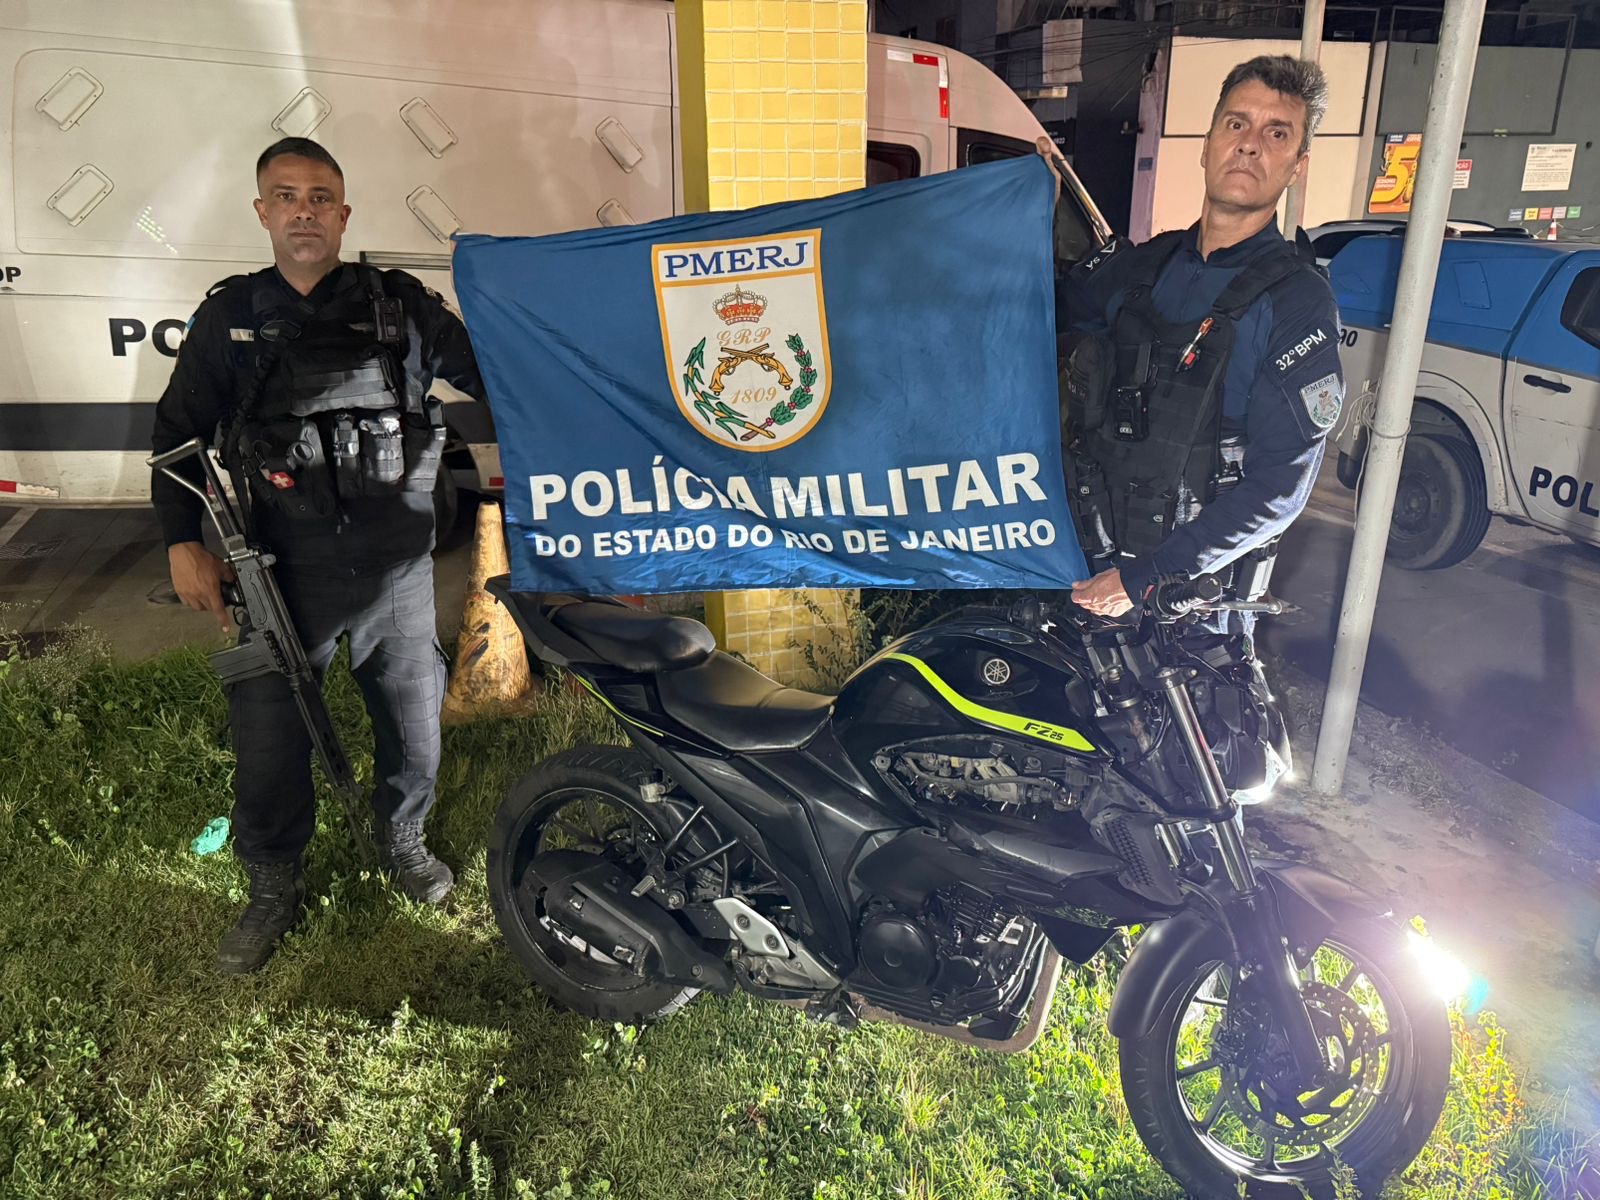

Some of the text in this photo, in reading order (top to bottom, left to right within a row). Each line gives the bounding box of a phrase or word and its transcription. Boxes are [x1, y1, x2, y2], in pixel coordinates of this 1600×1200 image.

[664, 242, 808, 278] PMERJ
[0, 266, 21, 282] P
[717, 327, 771, 346] GRP
[1304, 375, 1335, 393] PMERJ
[730, 387, 777, 404] 1809
[529, 452, 1048, 520] POLÍCIA MILITAR
[1529, 466, 1599, 517] POL
[535, 518, 1056, 558] DO ESTADO DO RIO DE JANEIRO
[1023, 722, 1064, 741] FZ25
